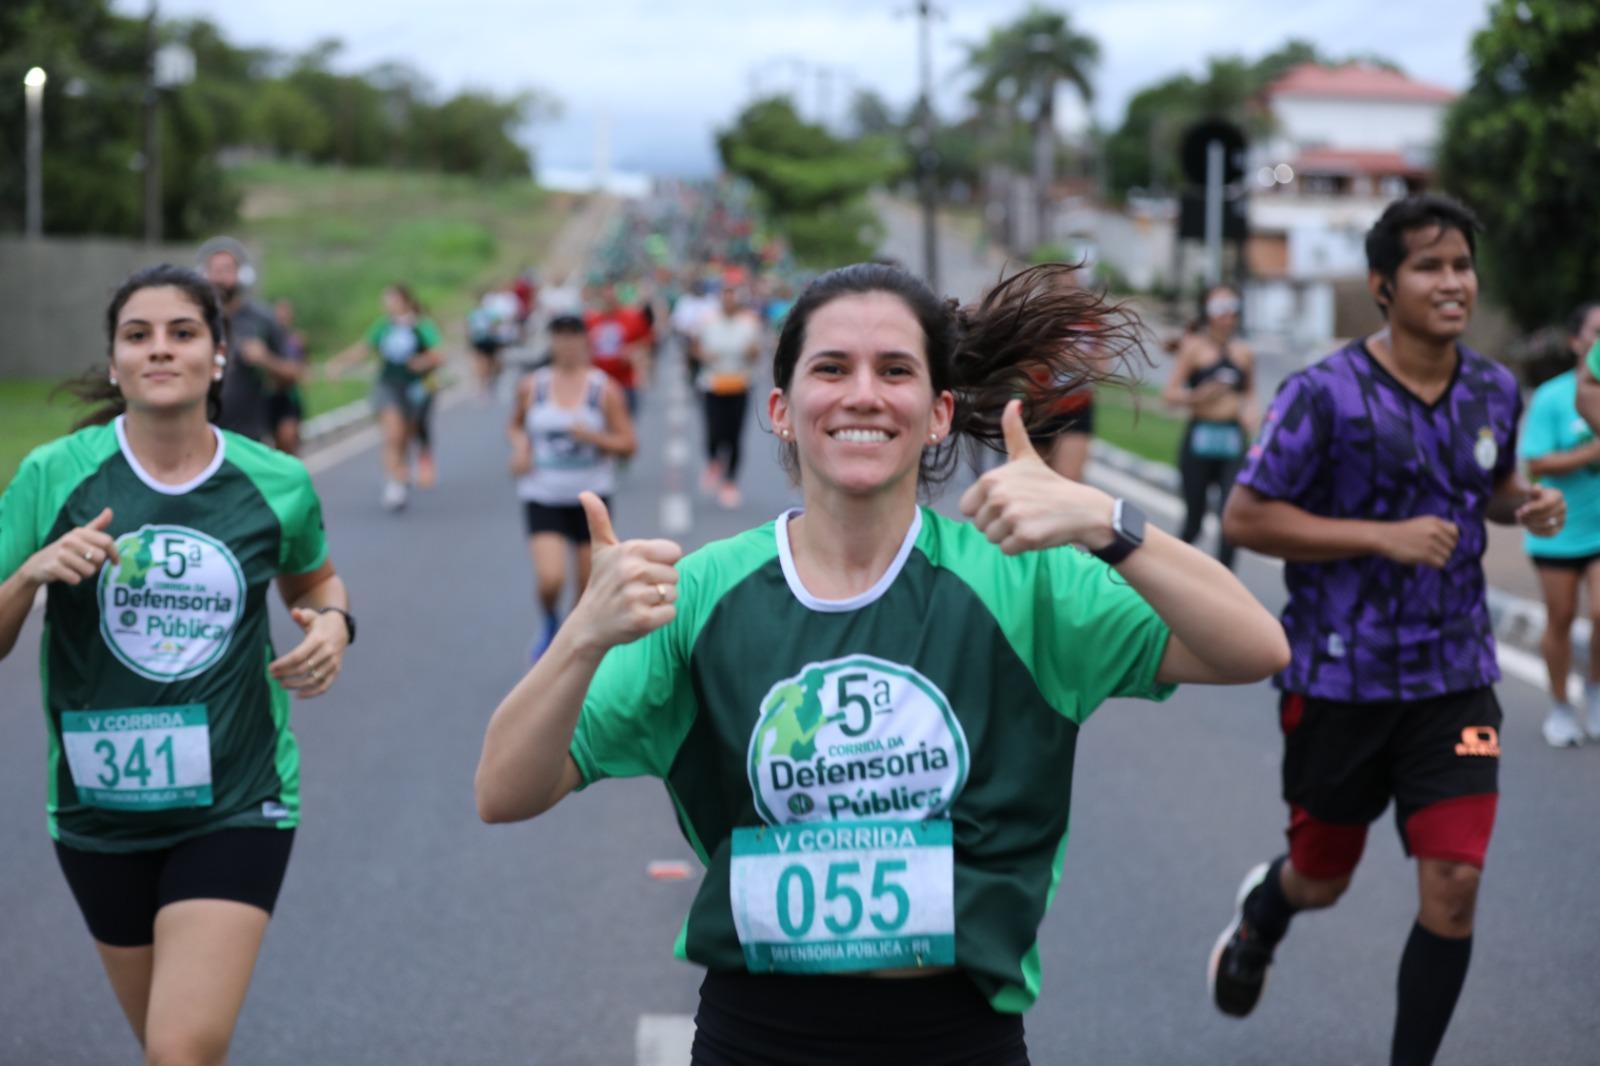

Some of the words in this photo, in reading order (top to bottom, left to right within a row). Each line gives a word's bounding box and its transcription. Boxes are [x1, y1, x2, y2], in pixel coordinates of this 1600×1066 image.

[113, 587, 232, 613] Defensoria
[146, 614, 225, 641] Pública
[88, 716, 100, 731] V
[104, 712, 184, 731] CORRIDA
[828, 738, 885, 758] CORRIDA
[887, 735, 905, 750] DA
[94, 735, 176, 788] 341
[769, 741, 950, 791] Defensoria
[827, 786, 942, 821] Pública
[774, 831, 792, 853] V
[797, 826, 918, 851] CORRIDA
[776, 859, 911, 938] 055
